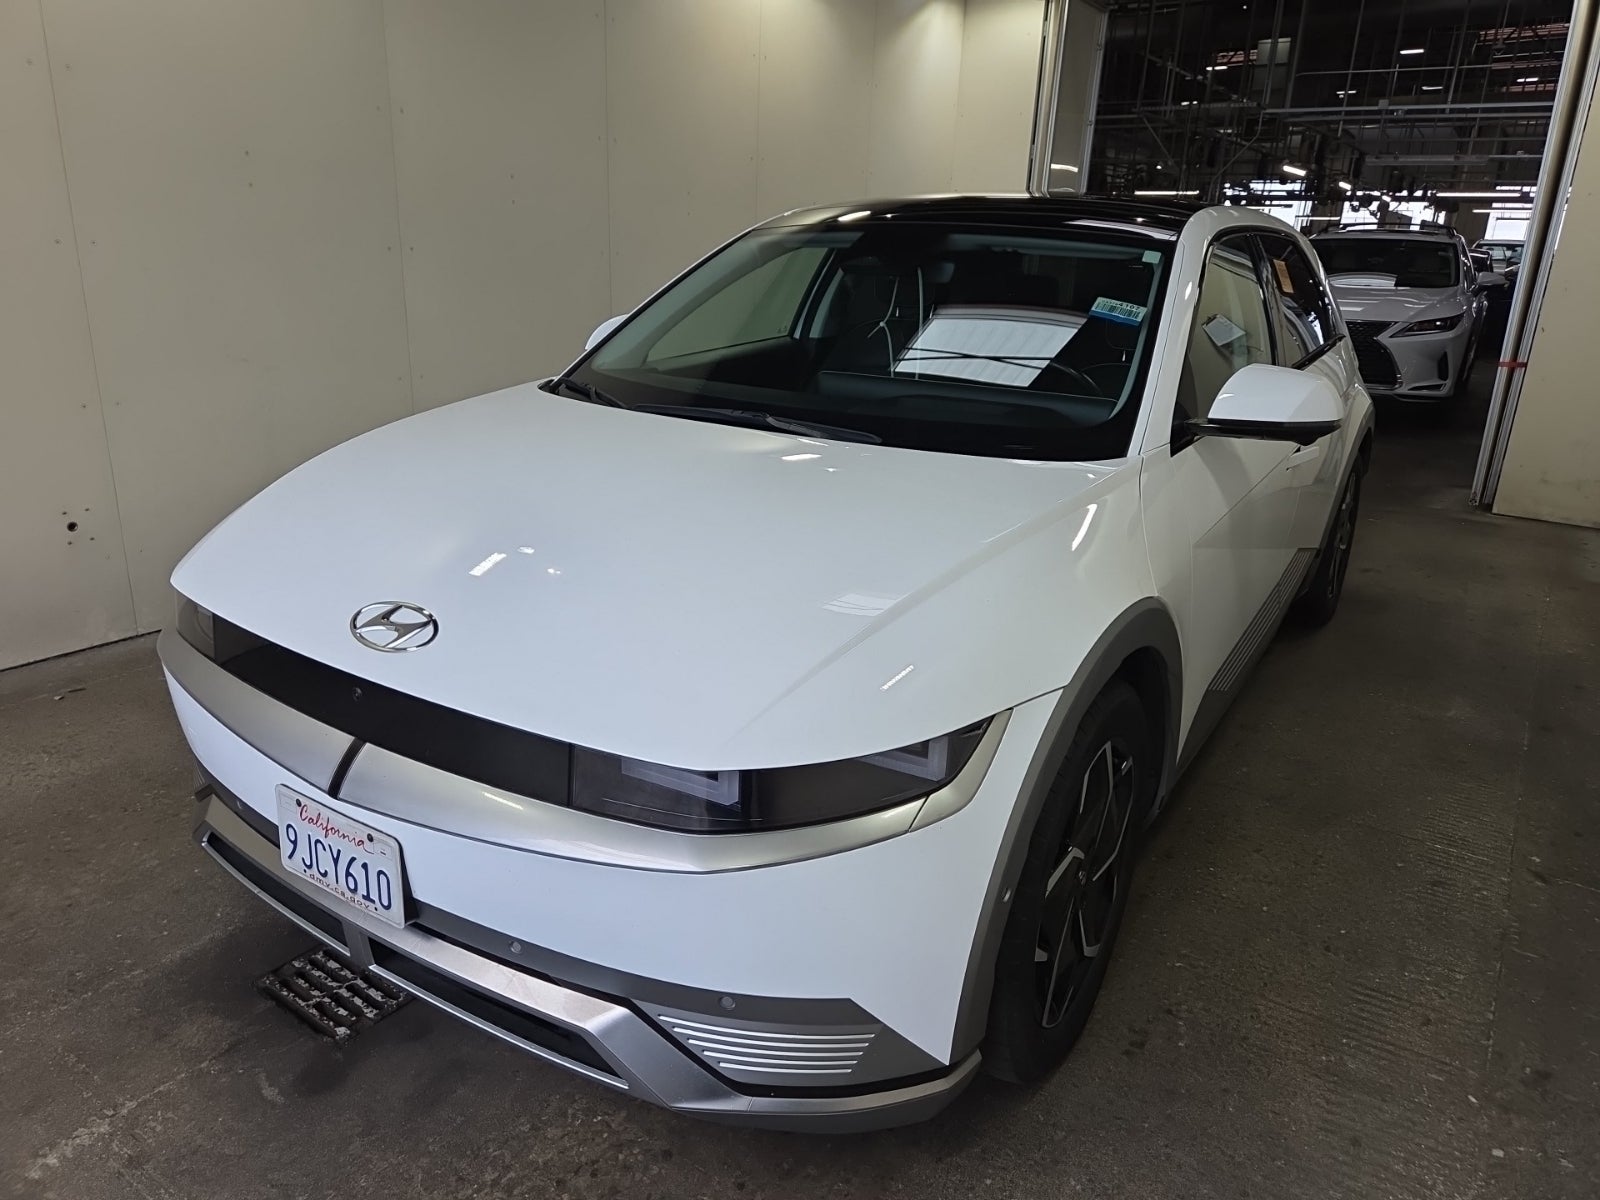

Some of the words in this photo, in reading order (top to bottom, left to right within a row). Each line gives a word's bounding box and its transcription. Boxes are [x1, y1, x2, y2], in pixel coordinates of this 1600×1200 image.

[299, 804, 374, 855] California
[285, 823, 392, 911] 9JCY610
[309, 873, 370, 909] dmv.ca.gov
